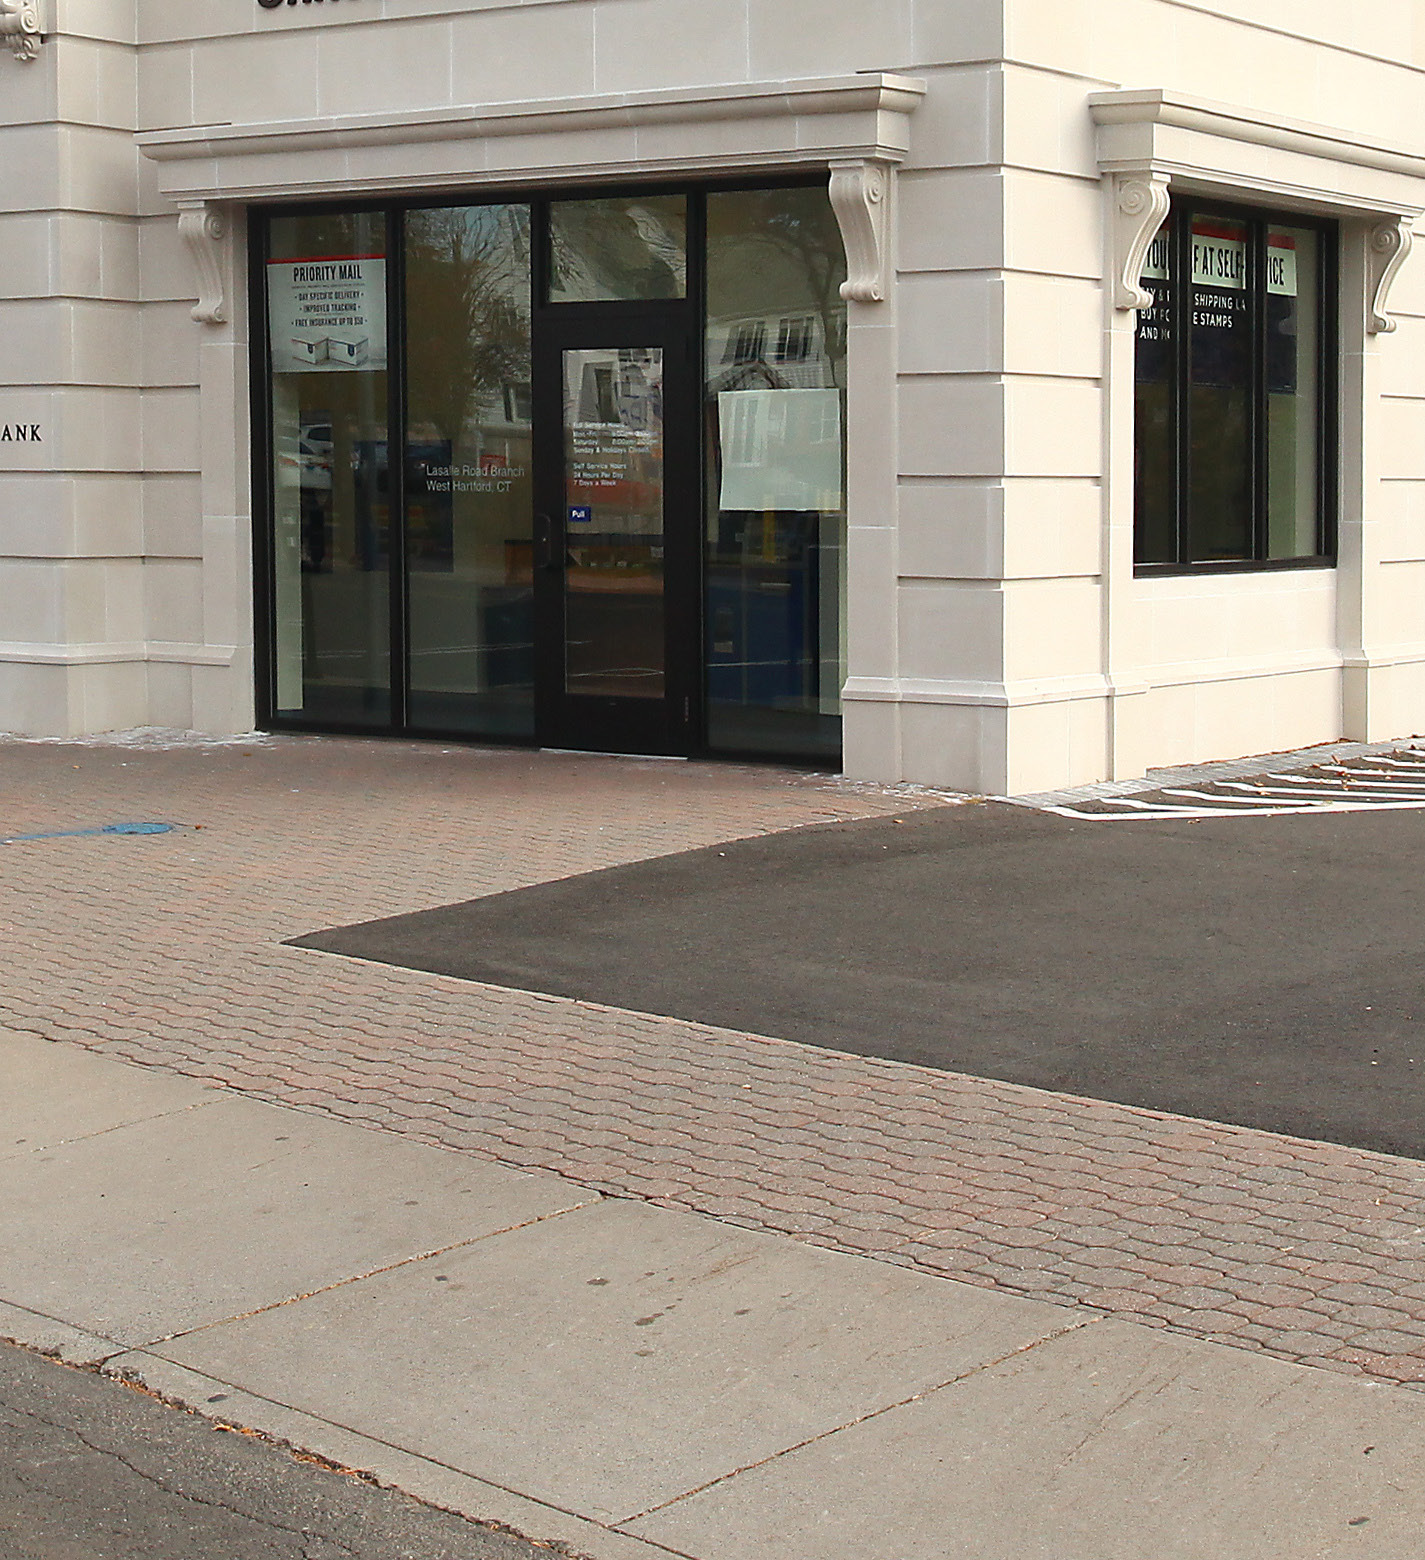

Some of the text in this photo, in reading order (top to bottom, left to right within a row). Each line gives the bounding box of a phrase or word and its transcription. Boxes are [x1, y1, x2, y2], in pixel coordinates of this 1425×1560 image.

[1202, 246, 1214, 275] AT
[293, 264, 362, 282] PRIORITY MAIL
[1194, 293, 1233, 310] SHIPPING
[1141, 307, 1157, 320] BUY
[1200, 312, 1233, 328] STAMPS
[1140, 326, 1158, 340] AND
[462, 465, 488, 477] Road
[490, 466, 525, 477] Branch
[426, 480, 451, 491] West
[496, 481, 512, 492] CT
[572, 509, 586, 518] Pull
